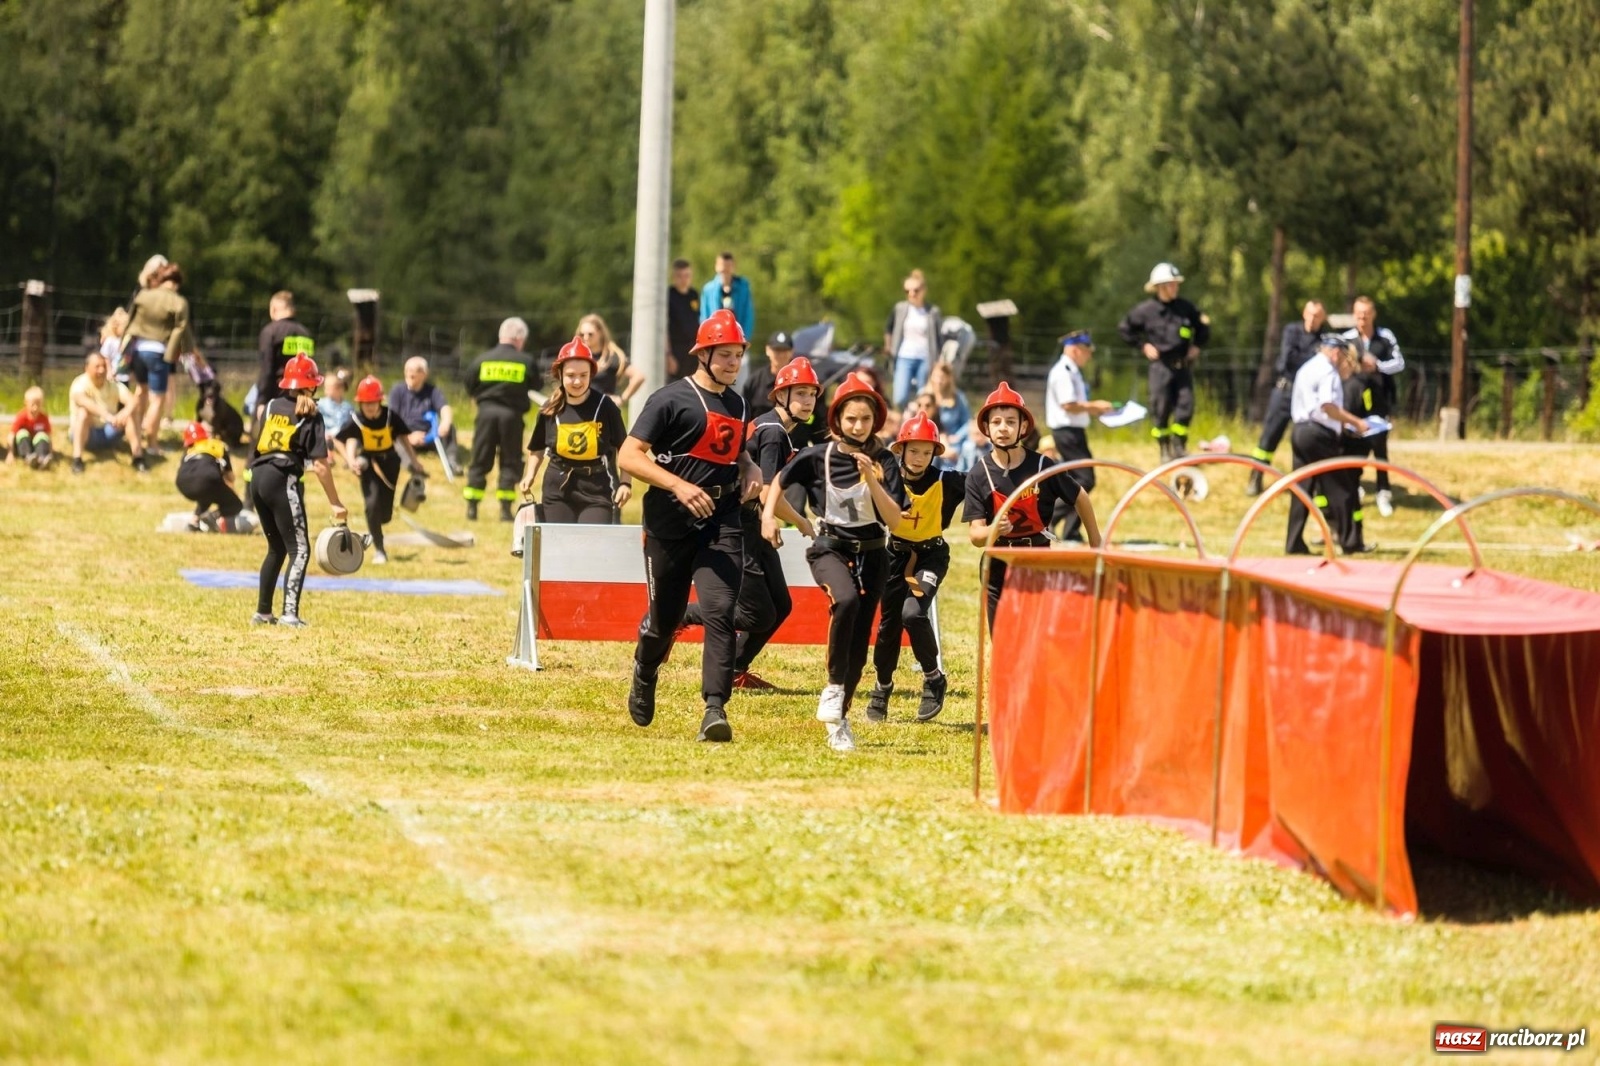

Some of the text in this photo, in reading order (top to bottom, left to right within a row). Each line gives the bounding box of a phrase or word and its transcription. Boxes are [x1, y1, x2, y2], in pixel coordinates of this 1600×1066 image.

[268, 430, 284, 449] 8
[567, 431, 588, 455] 9
[709, 424, 735, 455] 3
[839, 497, 859, 522] 1
[901, 498, 923, 530] 4
[1008, 507, 1034, 533] 2
